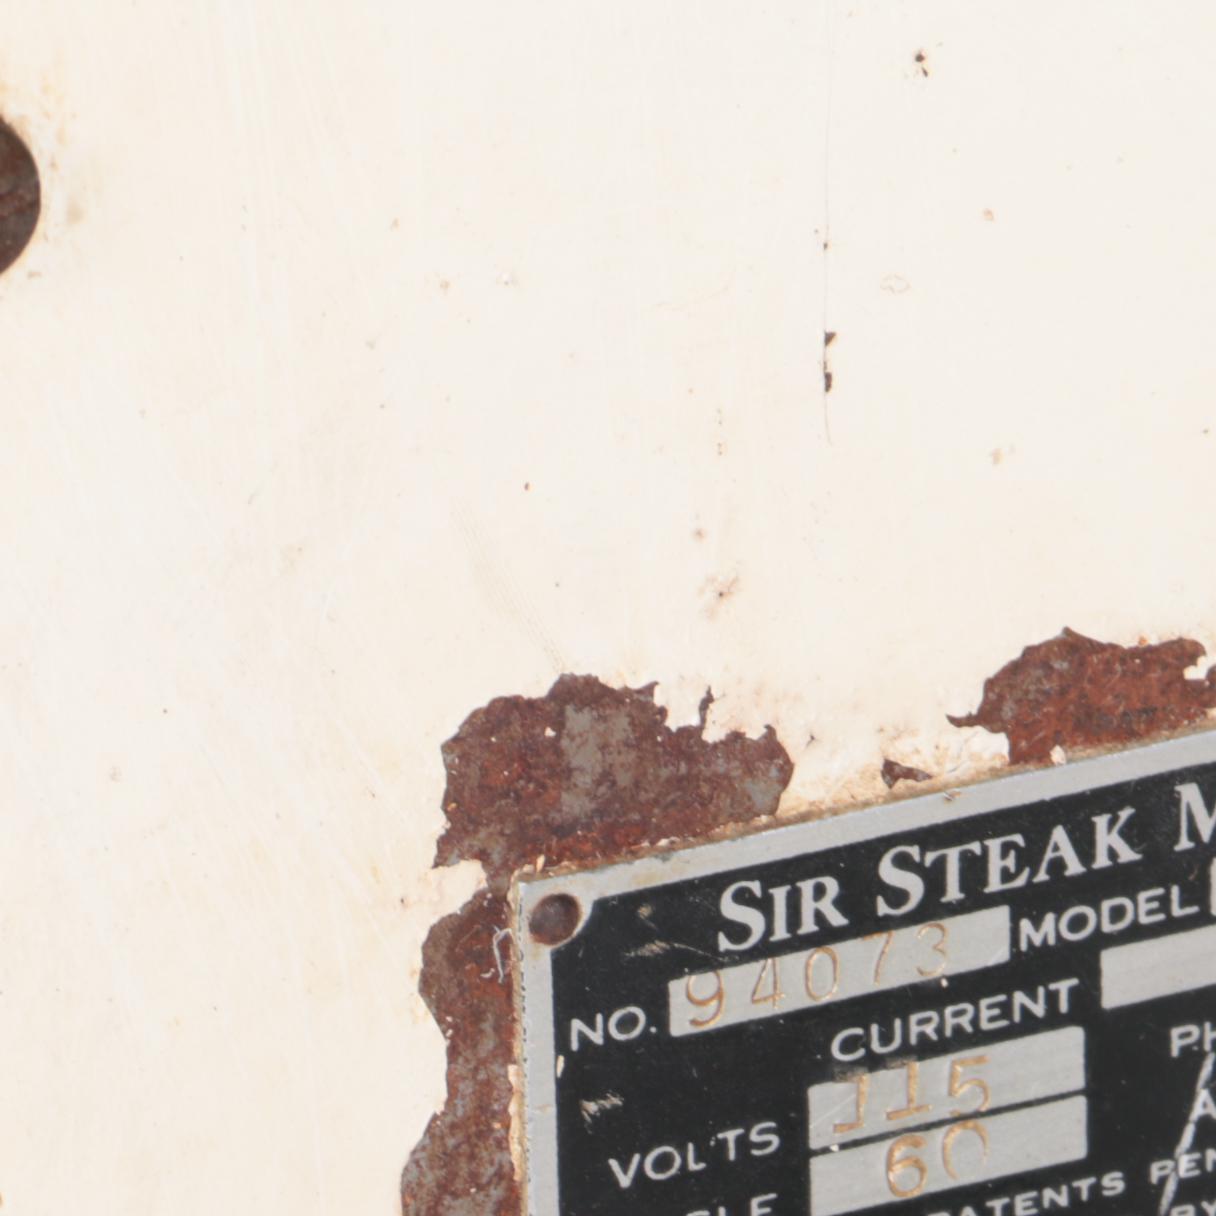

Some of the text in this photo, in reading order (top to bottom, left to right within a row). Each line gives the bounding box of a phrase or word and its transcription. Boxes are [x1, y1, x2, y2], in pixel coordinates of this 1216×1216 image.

[717, 876, 849, 952] SIR
[875, 806, 1143, 917] STEAK
[569, 1005, 657, 1052] NO.
[685, 921, 948, 1028] 94073
[1018, 884, 1200, 951] MODEL
[829, 978, 1080, 1063] CURRENT
[608, 1054, 991, 1189] VOLTS 115
[884, 1120, 990, 1199] 60
